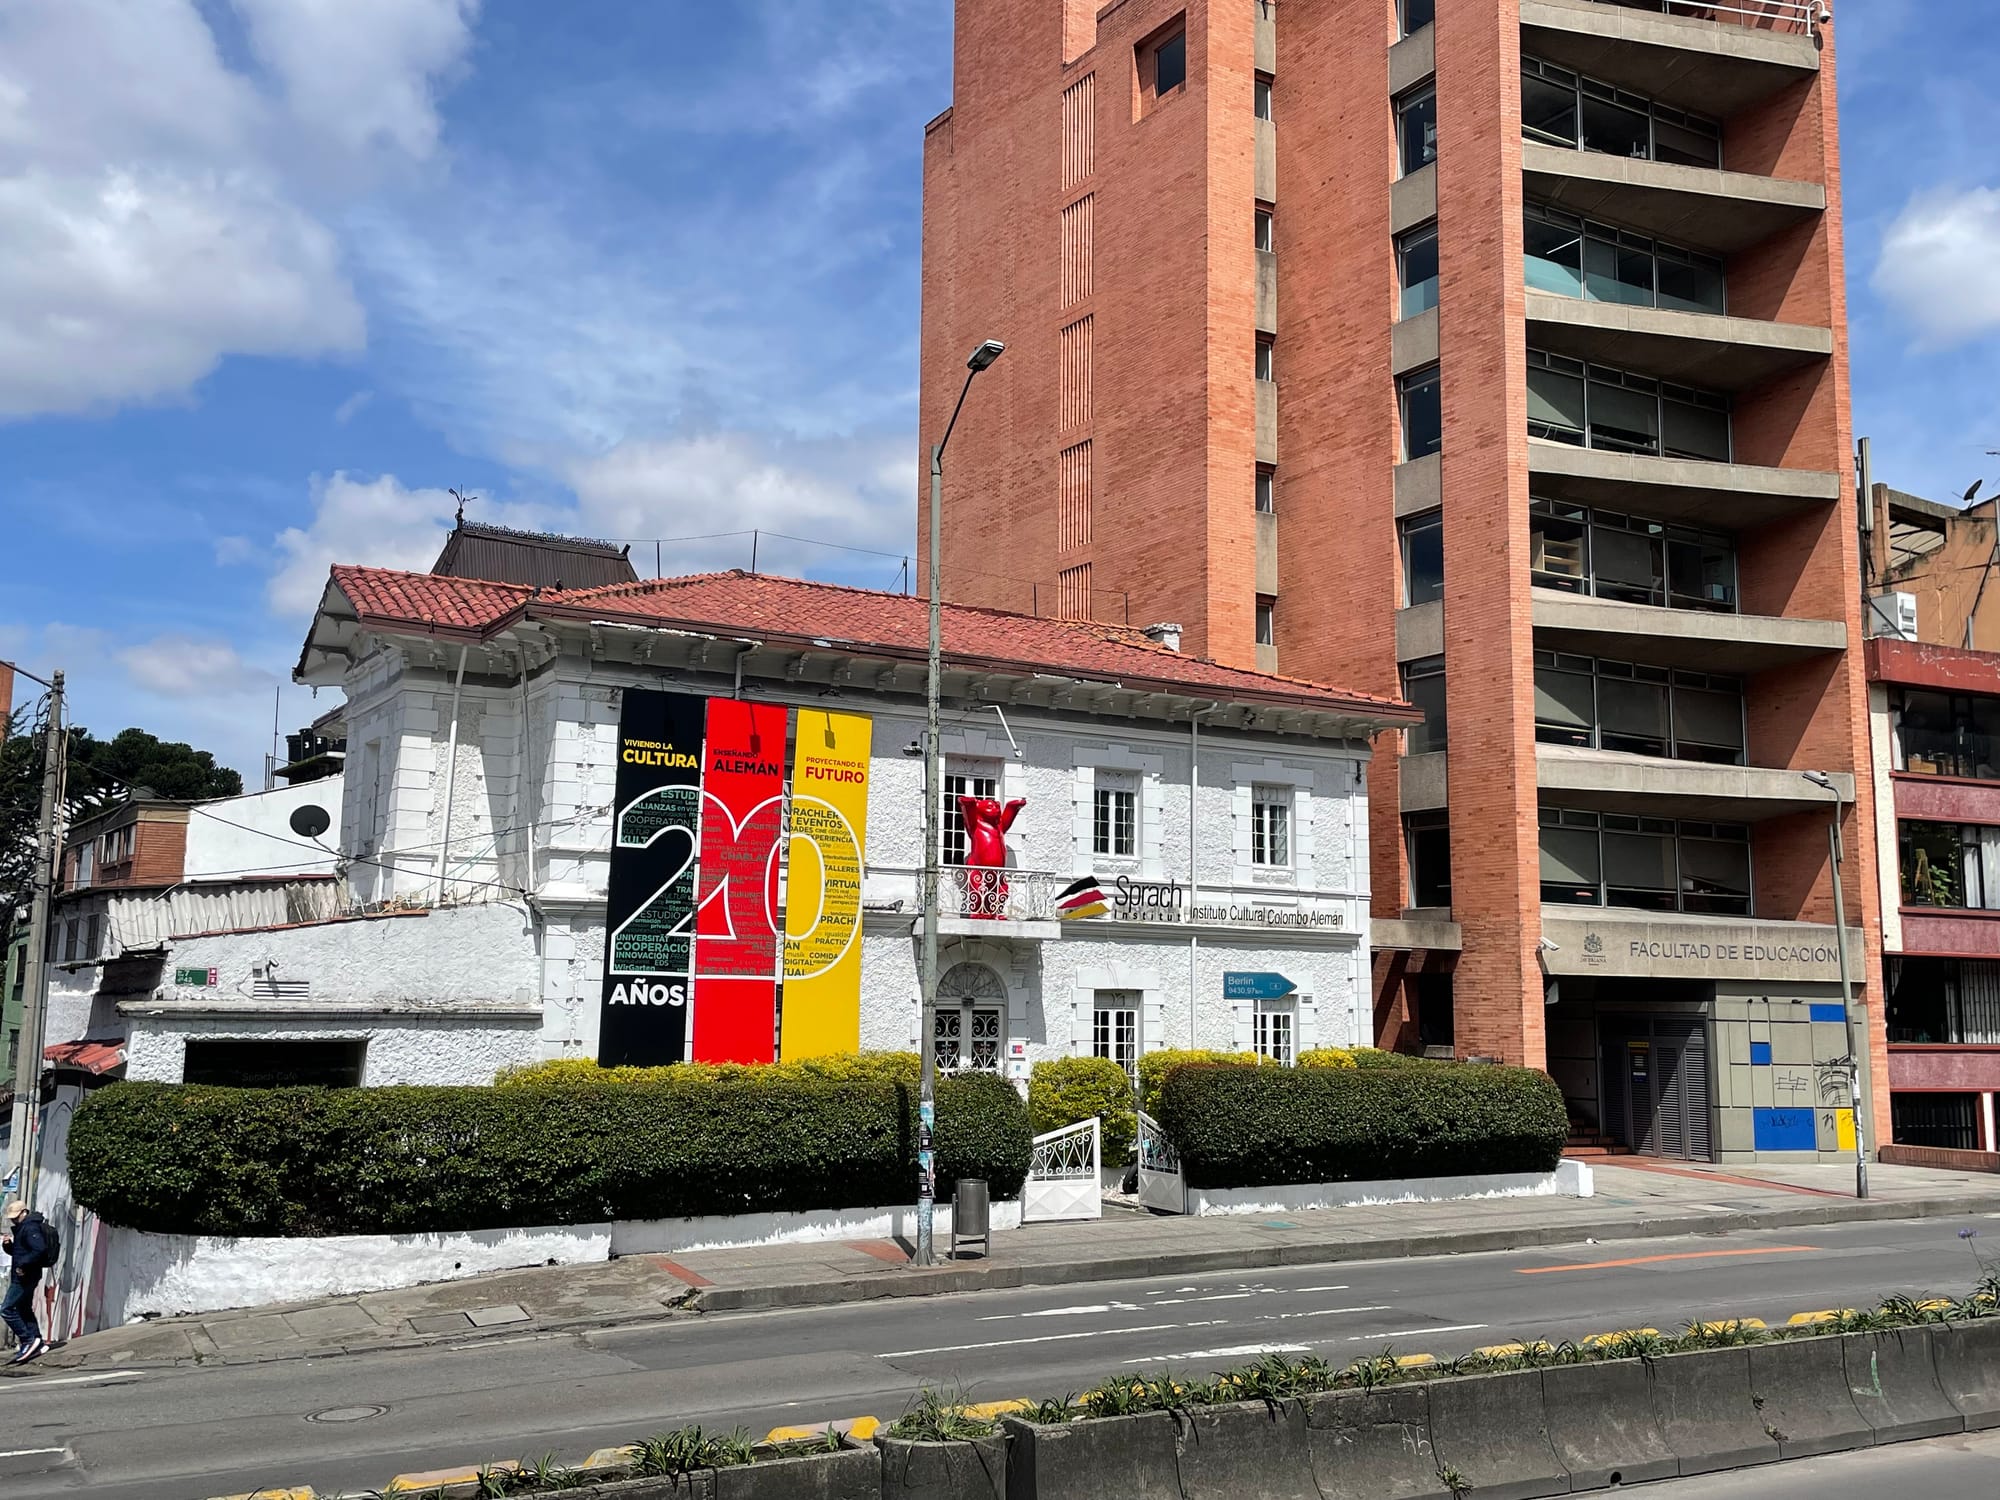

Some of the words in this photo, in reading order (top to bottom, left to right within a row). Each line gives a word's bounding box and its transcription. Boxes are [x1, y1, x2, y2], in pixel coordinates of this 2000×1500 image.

[624, 738, 662, 749] VIVIENDO
[623, 749, 698, 769] CULTURA
[806, 756, 857, 768] PROYECTANDO
[713, 759, 779, 776] ALEMÁN
[806, 766, 865, 784] FUTURO
[796, 816, 843, 829] EVENTOS
[824, 864, 860, 873] TALLERES
[1114, 875, 1182, 913] Sprach
[1114, 909, 1182, 922] Institut
[1190, 904, 1227, 921] Instituto
[1229, 905, 1266, 922] Cultural
[1267, 909, 1308, 926] Colombo
[1309, 910, 1344, 926] Alemán
[615, 941, 689, 954] COOPERACIÓ
[1630, 941, 1711, 960] FACULTAD
[1716, 944, 1738, 960] DE
[1744, 943, 1838, 963] EDUCACIÓN
[784, 958, 815, 967] DIGITAL
[1228, 976, 1254, 985] Berlin
[608, 977, 686, 1007] AÑOS
